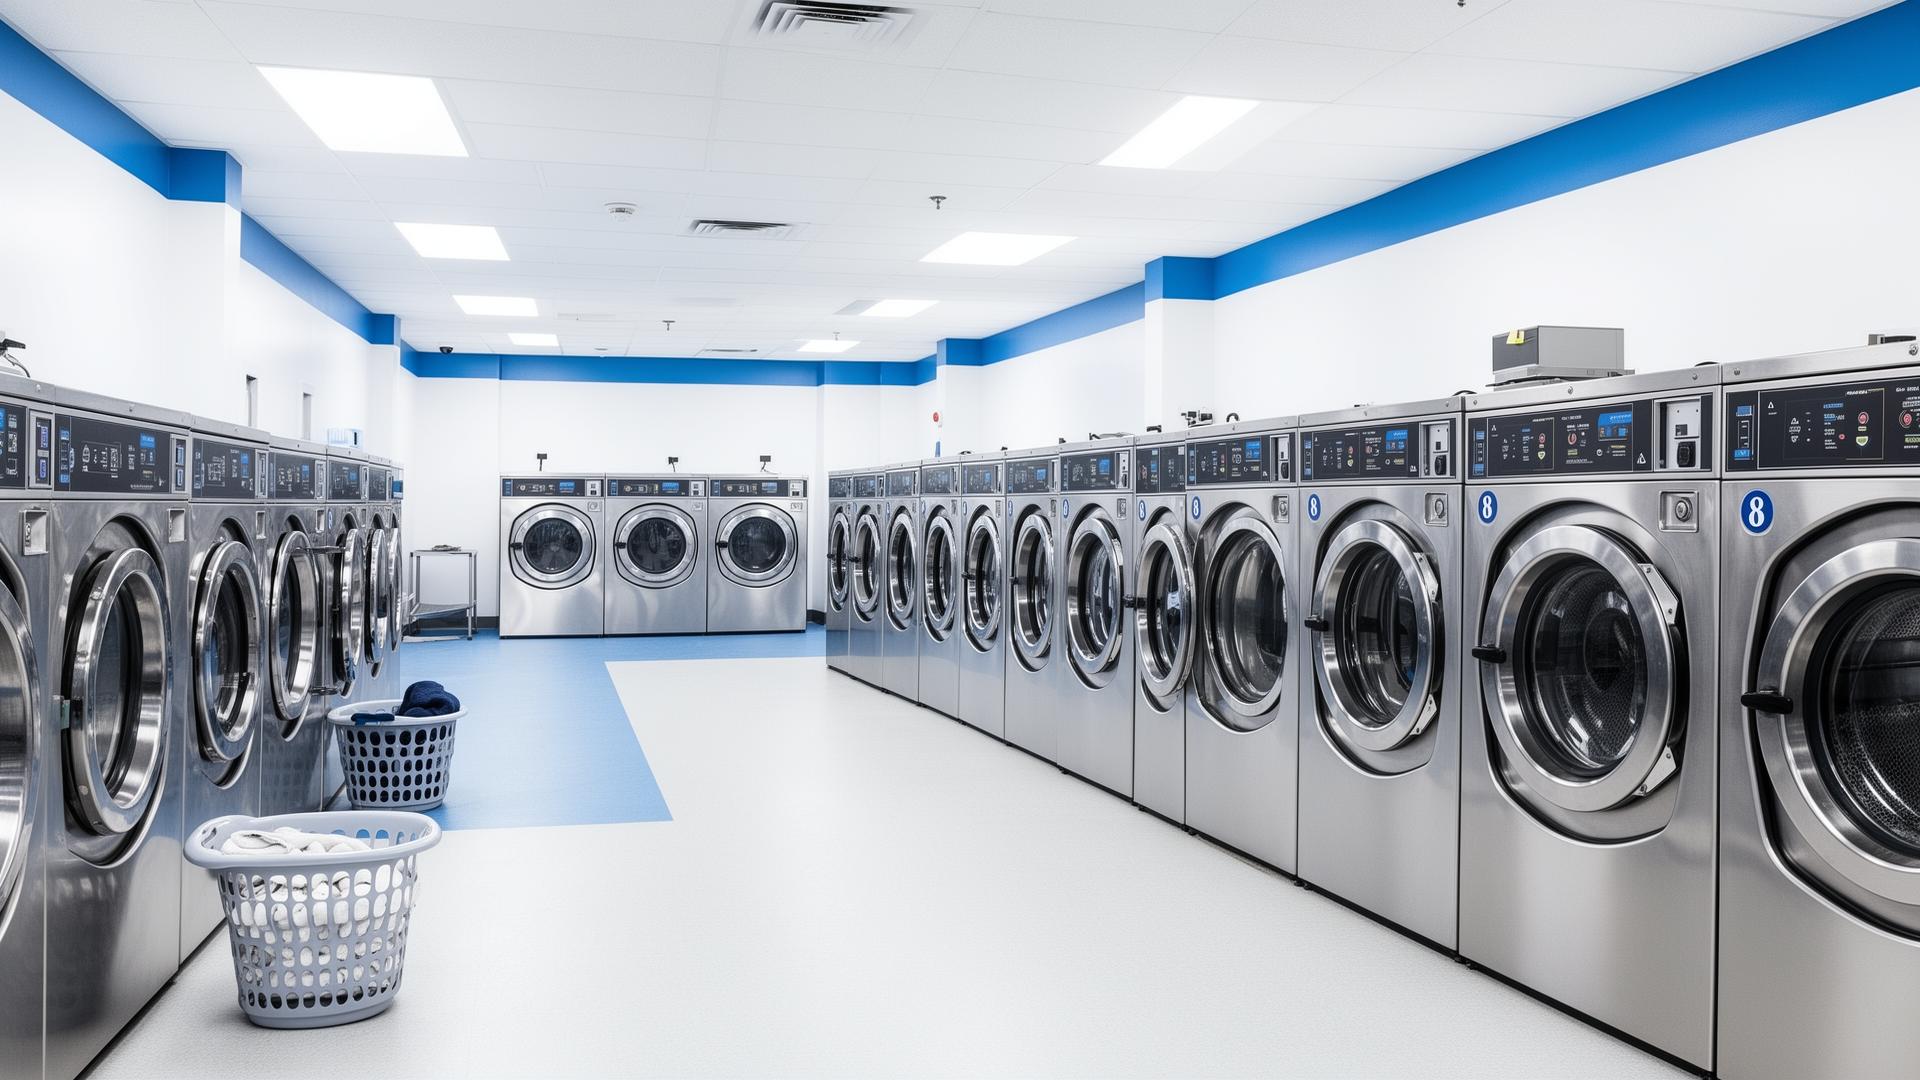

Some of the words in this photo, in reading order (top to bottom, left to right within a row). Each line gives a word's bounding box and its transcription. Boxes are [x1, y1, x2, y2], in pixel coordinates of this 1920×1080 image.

[1310, 497, 1317, 517] 8
[1482, 495, 1492, 519] 8
[1748, 496, 1765, 528] 8
